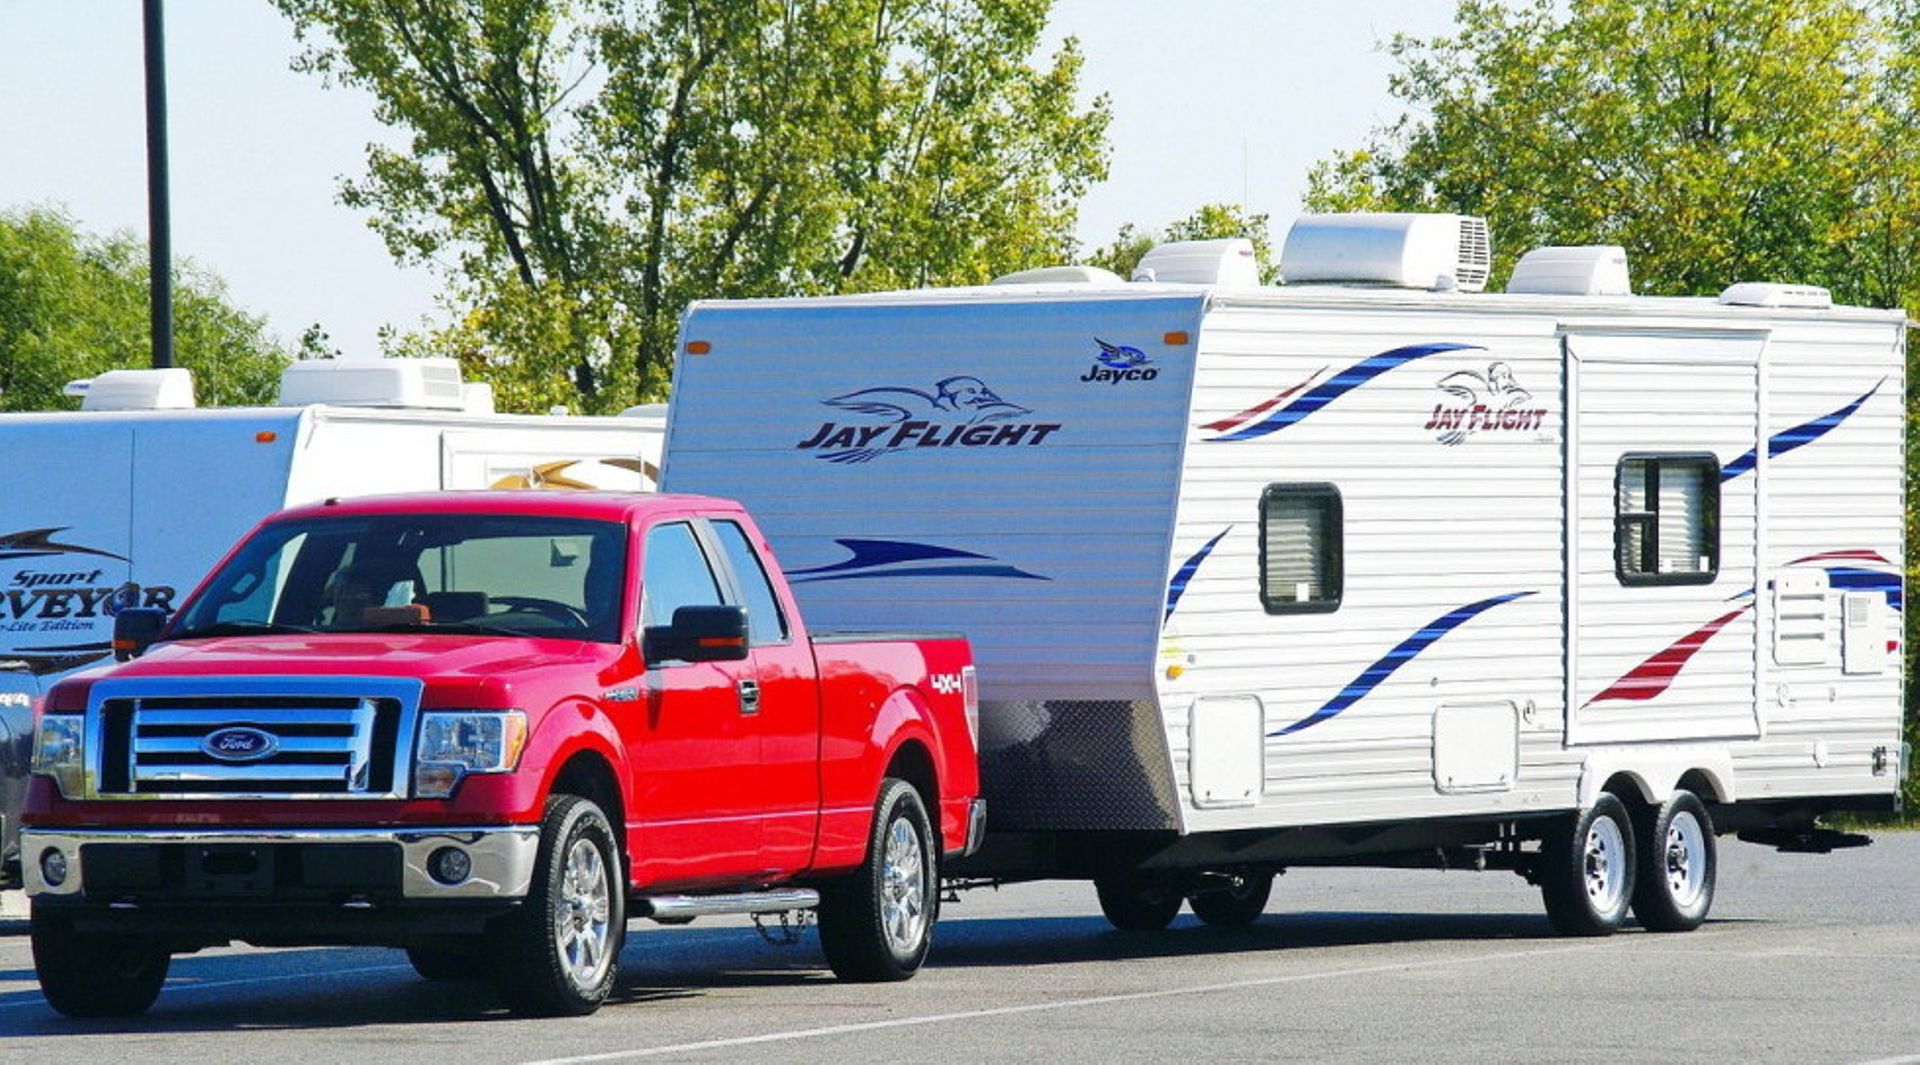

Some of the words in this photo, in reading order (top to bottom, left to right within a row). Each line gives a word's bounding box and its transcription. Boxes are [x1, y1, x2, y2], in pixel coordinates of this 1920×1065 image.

[1081, 365, 1158, 385] Jayco
[1424, 403, 1469, 430] JAY
[1468, 404, 1548, 430] FLIGHT
[797, 422, 890, 448] JAY
[886, 421, 1062, 448] FLIGHT
[9, 569, 103, 588] Sport
[0, 582, 177, 619] VEYOR
[219, 735, 254, 750] Ford
